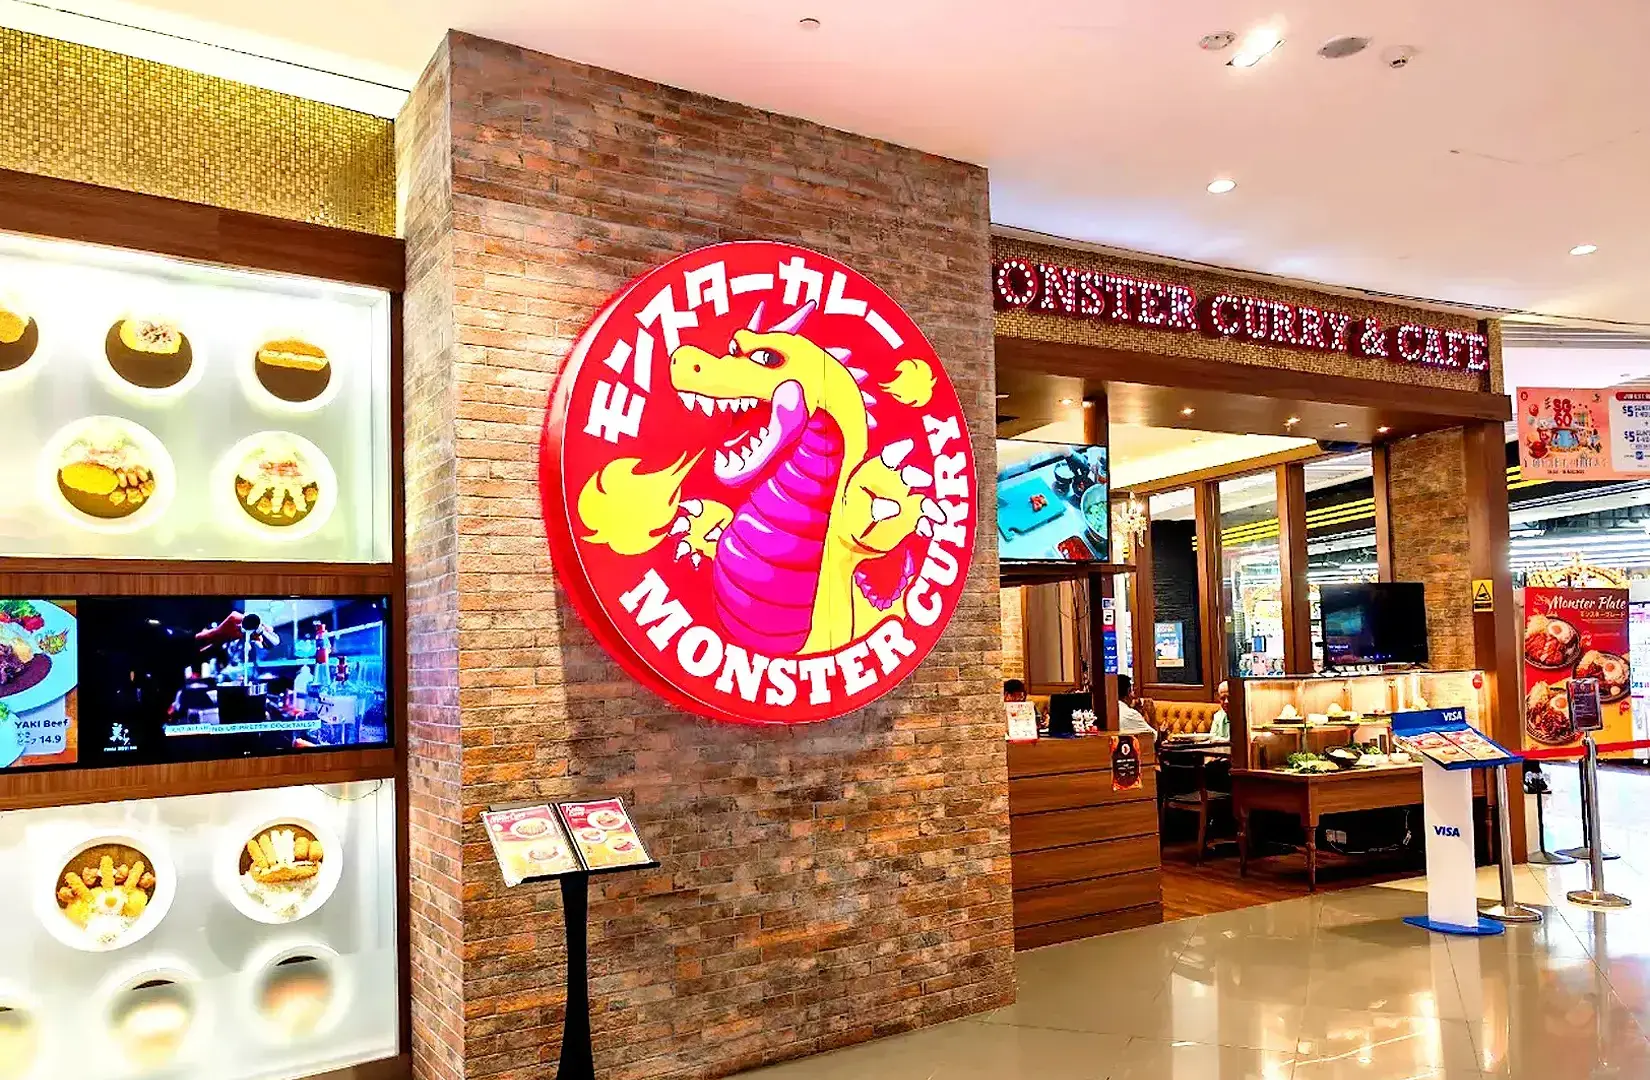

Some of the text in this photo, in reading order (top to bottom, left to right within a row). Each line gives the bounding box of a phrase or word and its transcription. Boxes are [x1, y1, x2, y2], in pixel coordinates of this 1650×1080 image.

[996, 257, 1488, 372] ONSTER CURRY & CAFE
[584, 257, 903, 444] モンスターカレー
[618, 414, 972, 707] MONSTER CURRY
[1548, 595, 1627, 610] Monster Plate
[1443, 711, 1463, 721] VISA
[15, 719, 68, 729] YAKI Beef
[39, 735, 62, 743] 14.9
[1434, 826, 1460, 837] VISA
